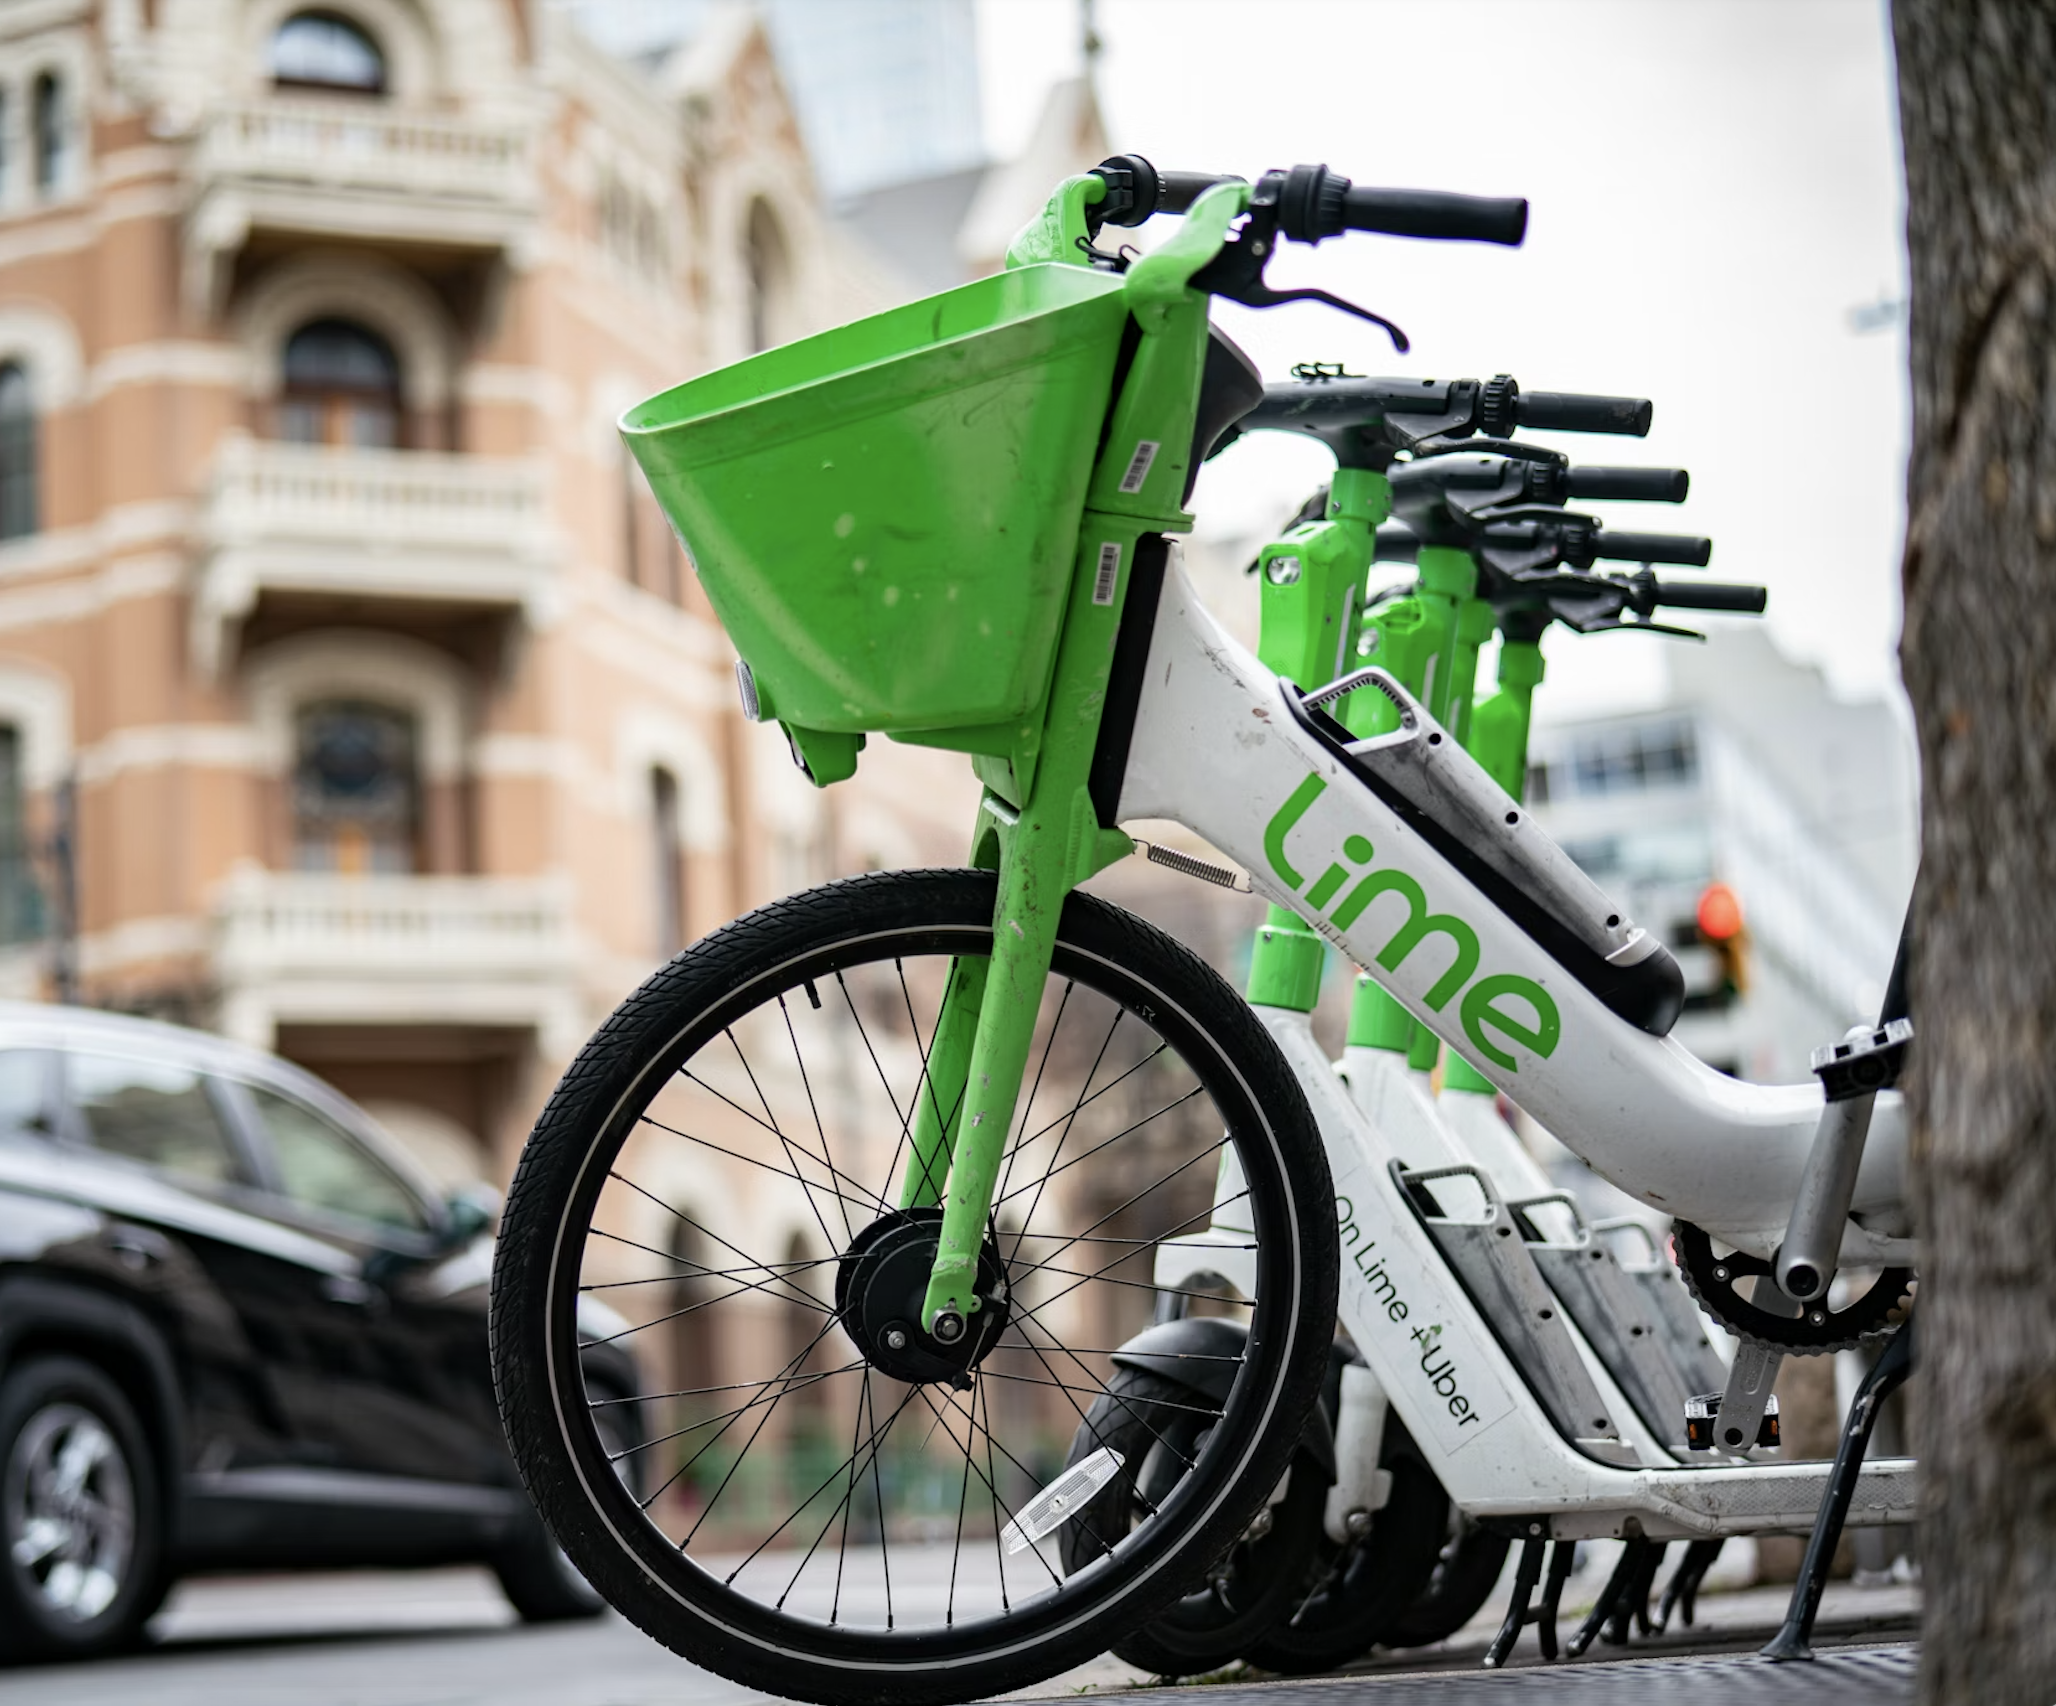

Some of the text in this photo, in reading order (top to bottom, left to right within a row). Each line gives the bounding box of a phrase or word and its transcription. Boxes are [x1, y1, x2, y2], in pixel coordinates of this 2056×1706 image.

[1264, 772, 1560, 1073] Lime
[1335, 1196, 1361, 1247] On
[1354, 1242, 1409, 1322] Lime
[1421, 1345, 1480, 1426] Uber
